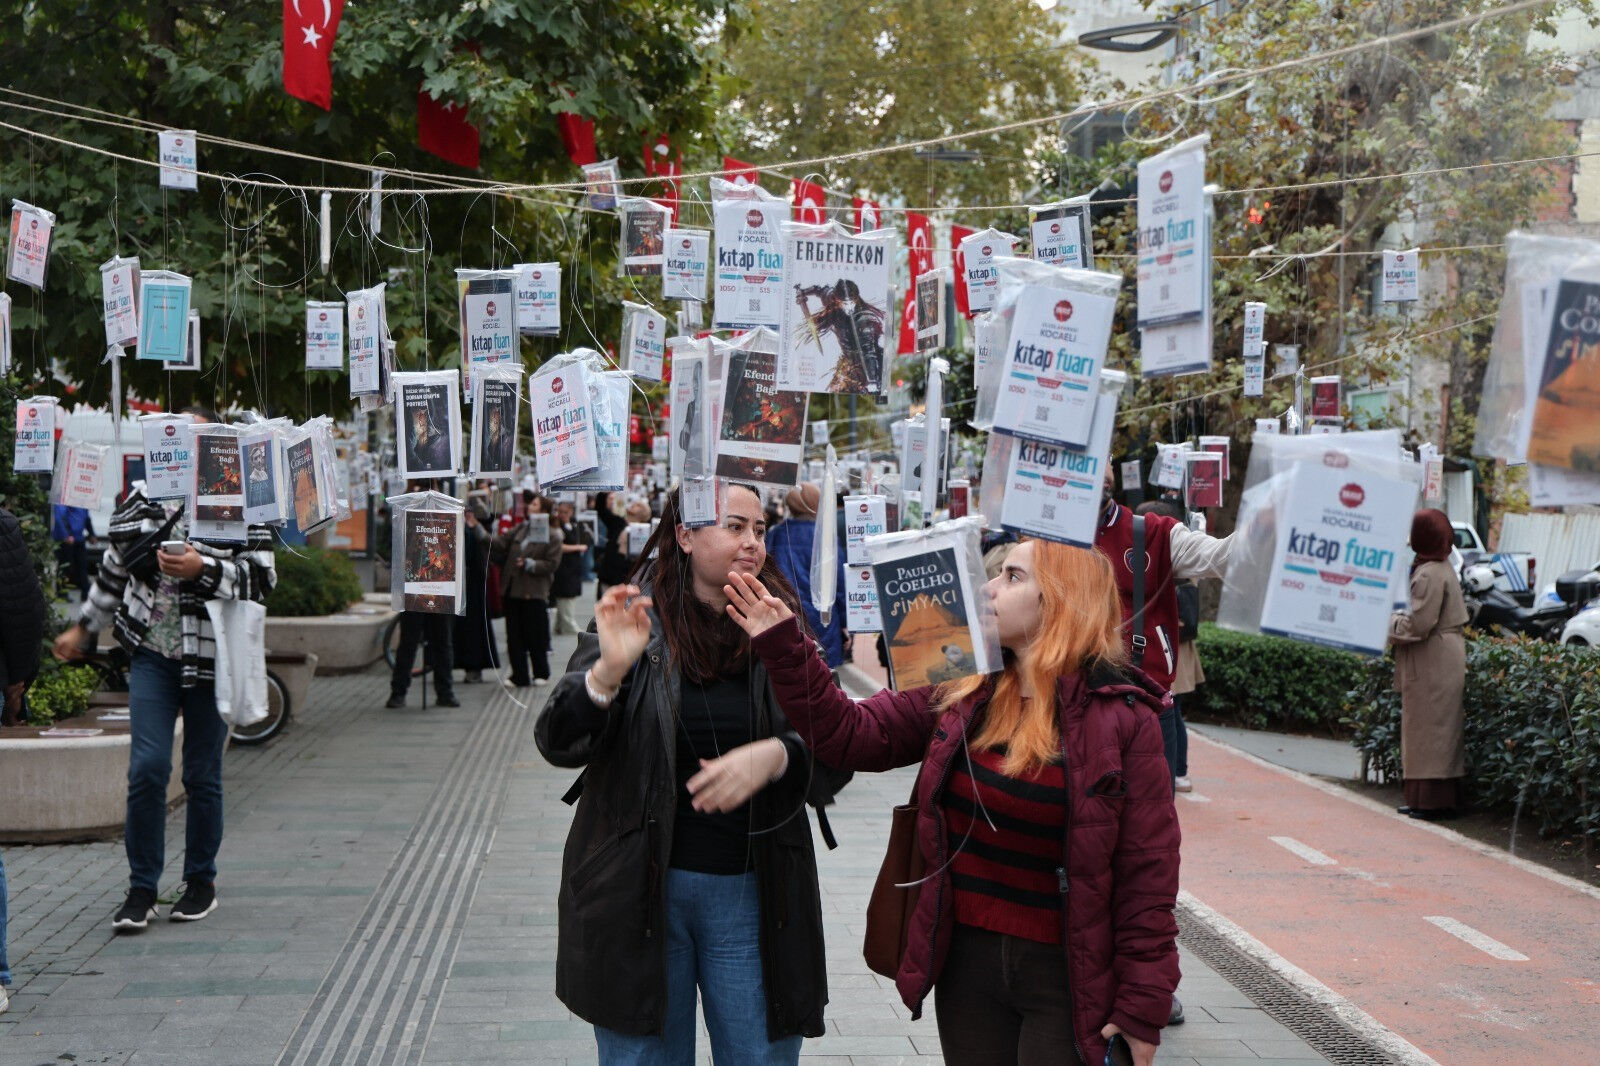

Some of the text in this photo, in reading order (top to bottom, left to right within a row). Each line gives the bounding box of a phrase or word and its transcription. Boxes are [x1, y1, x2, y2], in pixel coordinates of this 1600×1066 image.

[719, 247, 754, 271] kitap
[796, 240, 883, 266] ERGENEKON
[968, 269, 990, 279] kitap
[472, 335, 492, 353] kitap
[1013, 340, 1094, 377] kitap fuarı
[744, 368, 776, 381] Efend
[537, 414, 561, 435] kitap
[150, 449, 188, 463] kitap fua
[1018, 439, 1057, 471] kitap
[415, 526, 447, 534] Efendiler
[848, 525, 865, 536] kitap
[1287, 527, 1394, 572] kitap fuarı
[896, 564, 937, 580] PAULO
[885, 572, 953, 596] COELHO
[848, 592, 867, 603] kitap
[890, 589, 957, 616] SİMYACI
